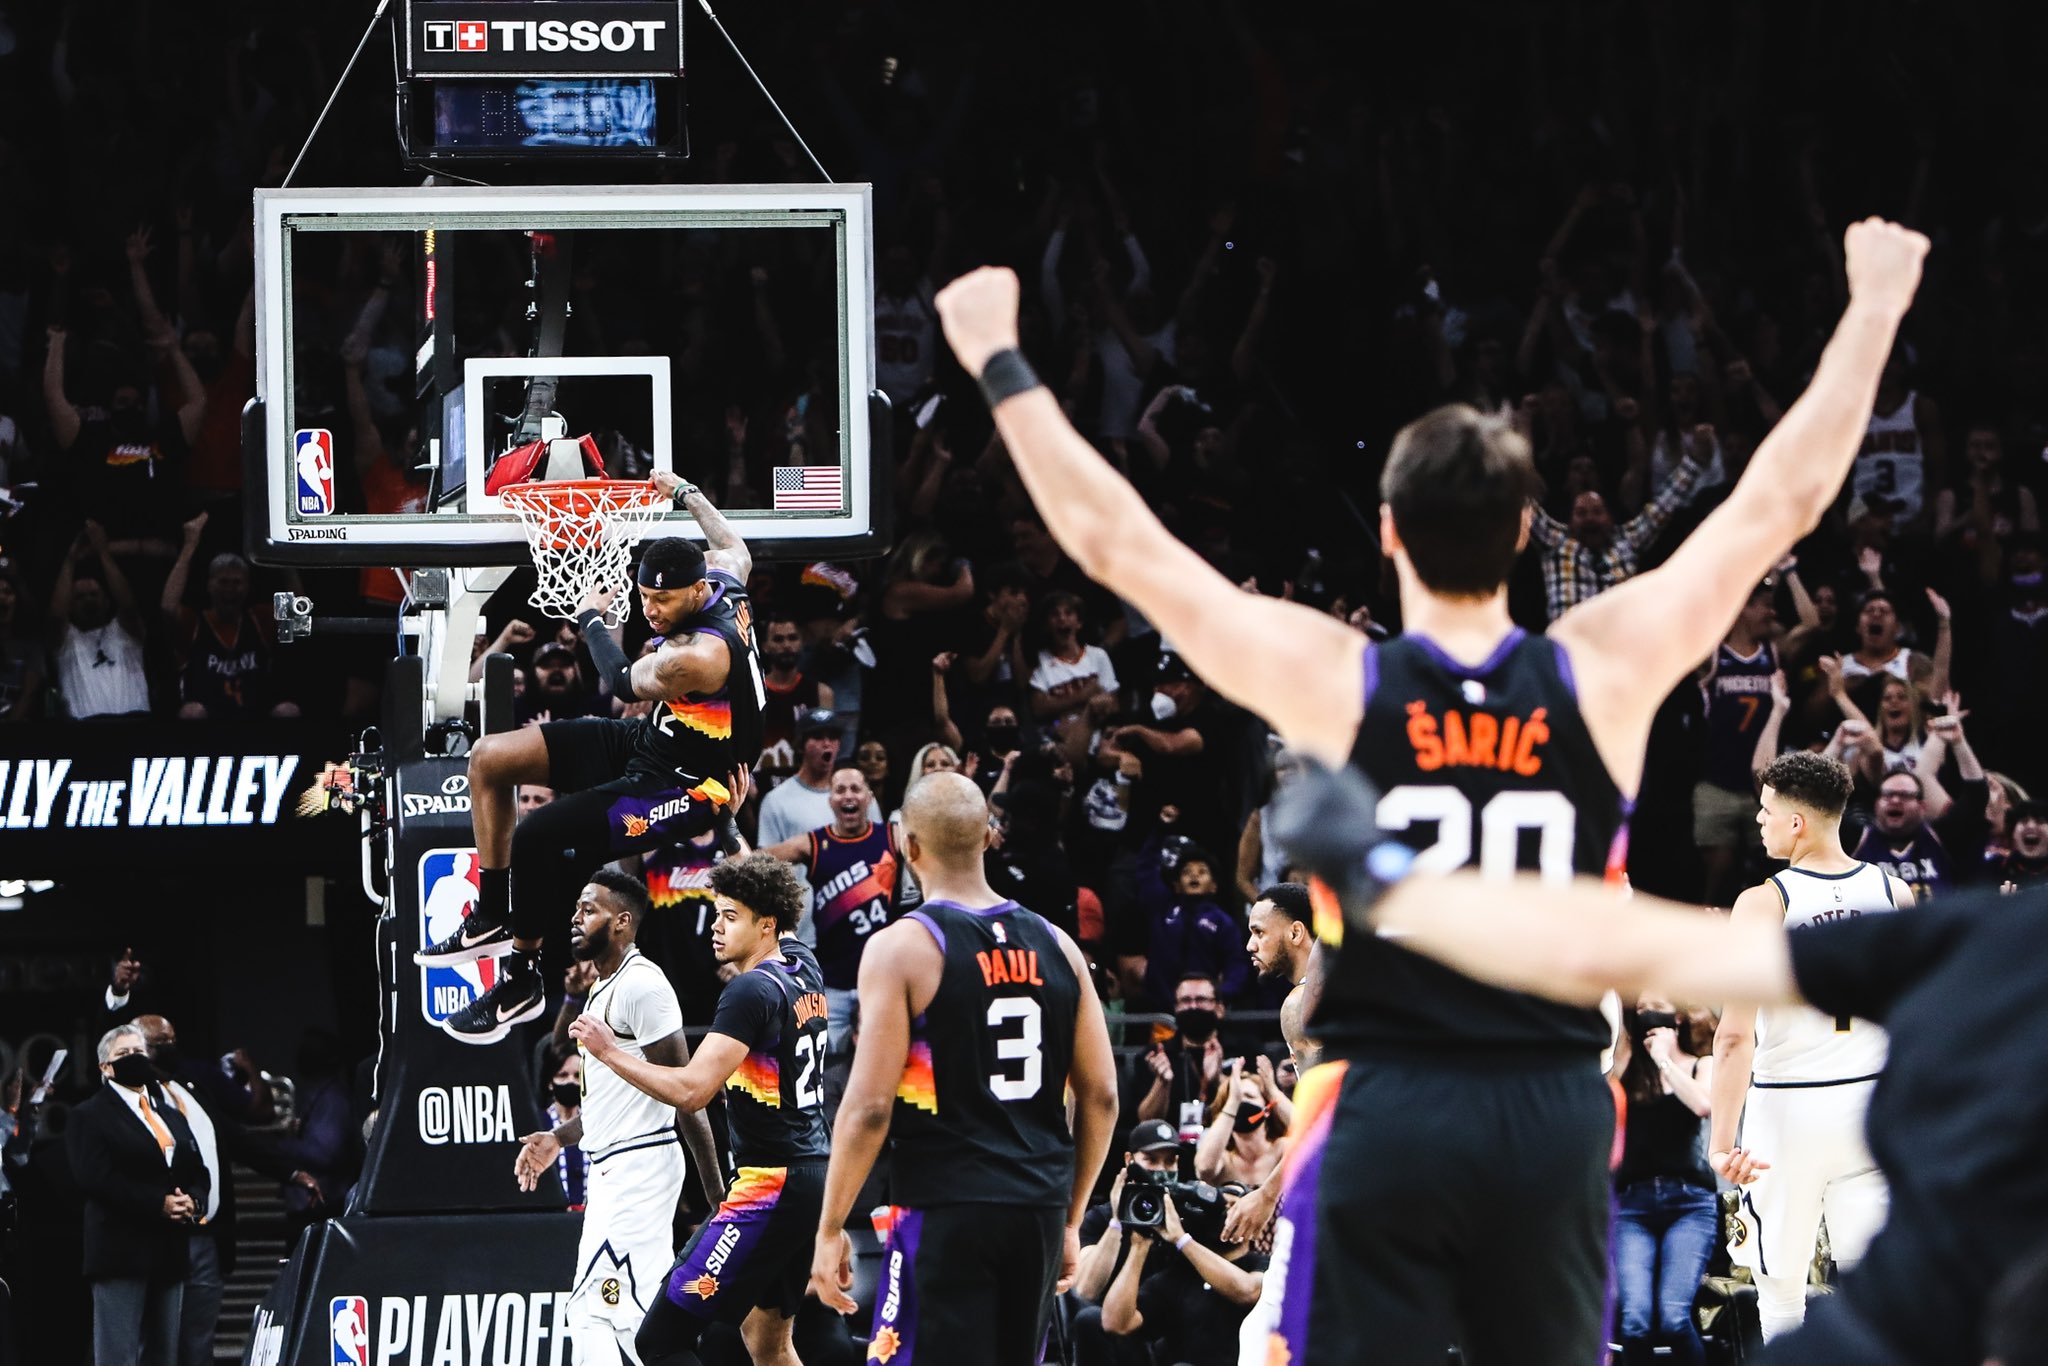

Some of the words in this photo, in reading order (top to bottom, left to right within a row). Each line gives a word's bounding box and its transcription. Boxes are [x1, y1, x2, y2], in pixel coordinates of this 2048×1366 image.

[491, 20, 666, 52] TISSOT
[301, 496, 321, 511] NBA
[288, 527, 347, 541] SPALDING
[1738, 695, 1759, 732] 7
[1405, 699, 1551, 777] ŠARIĆ
[65, 779, 127, 828] THE
[128, 754, 300, 827] VALLEY
[849, 898, 888, 936] 34
[976, 948, 1044, 987] PAUL
[434, 985, 472, 1015] NBA
[987, 996, 1043, 1102] 3
[418, 1084, 516, 1146] @NBA
